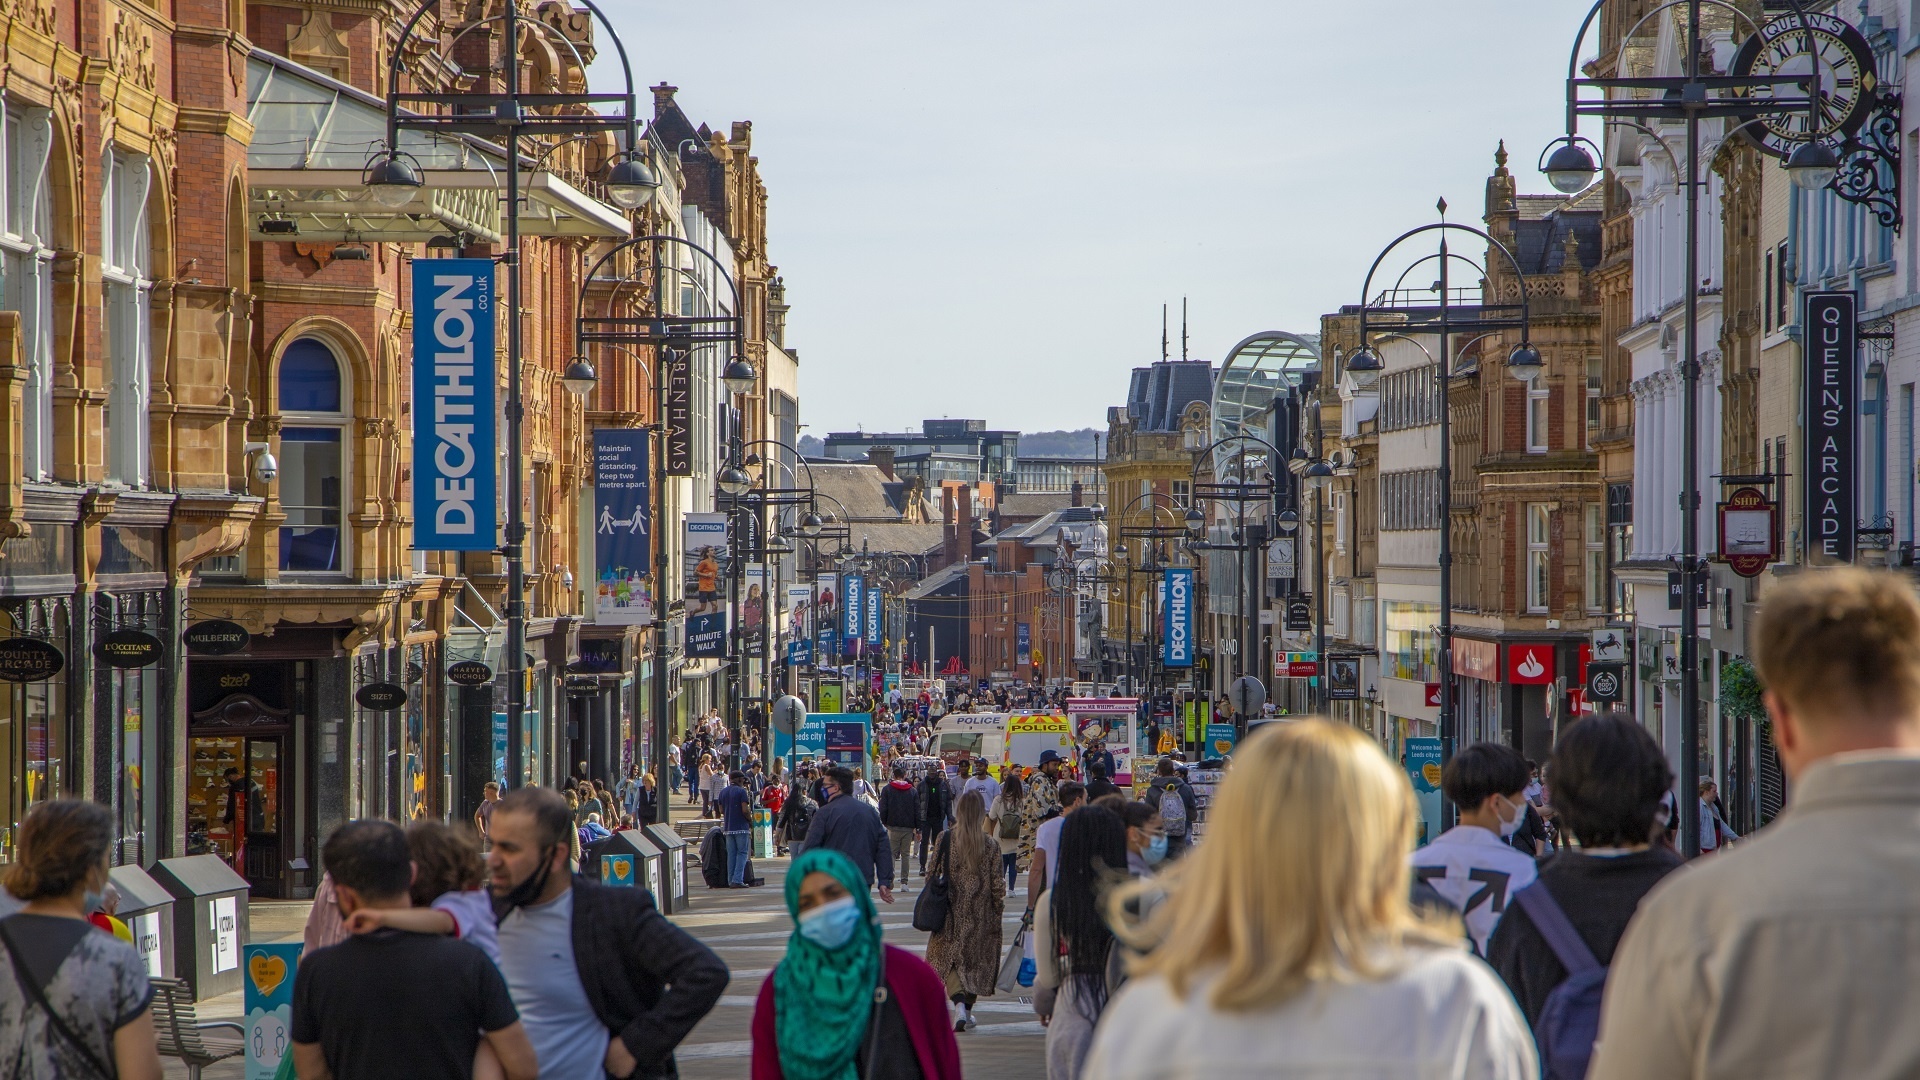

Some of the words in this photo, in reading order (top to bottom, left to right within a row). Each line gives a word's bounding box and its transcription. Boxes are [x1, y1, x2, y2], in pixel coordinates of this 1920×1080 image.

[1766, 14, 1842, 35] QUEN'S
[1821, 307, 1844, 427] QUEEN'S
[433, 275, 475, 534] DECATHLON
[476, 275, 487, 313] .co.uk
[673, 349, 686, 470] EBENHAMS
[599, 463, 638, 471] distancing.
[1734, 497, 1760, 505] SHIP
[1820, 436, 1839, 555] ARCADE
[849, 579, 858, 635] DECATHLON
[868, 591, 877, 641] DECATHLON
[1171, 573, 1186, 660] DECATHLON
[190, 633, 242, 642] MULBERRY
[690, 635, 695, 643] 5
[695, 631, 722, 642] MINUTE
[104, 642, 152, 651] L'OCCITANE
[696, 641, 716, 651] WALK
[580, 652, 617, 661] HAMS
[0, 660, 51, 669] RCADE
[220, 673, 250, 687] size?
[957, 717, 1002, 725] POLICE
[1011, 724, 1067, 732] POLICE
[795, 732, 809, 740] eeds
[810, 732, 823, 742] city
